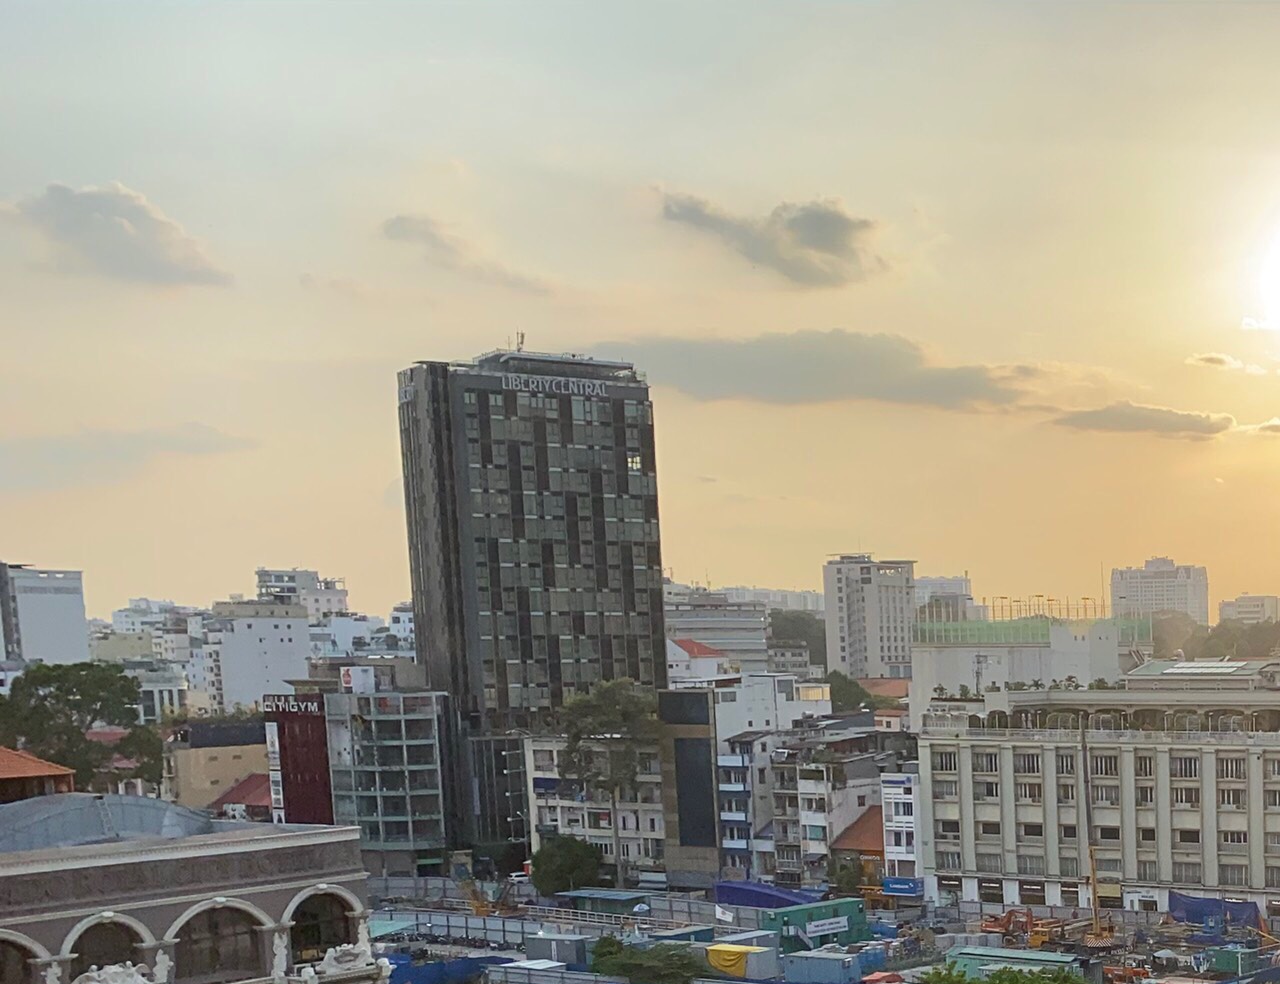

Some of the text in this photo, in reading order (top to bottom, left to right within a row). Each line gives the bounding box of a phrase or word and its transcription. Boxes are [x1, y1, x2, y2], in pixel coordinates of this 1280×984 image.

[502, 376, 609, 396] LIBERTY CENTRAL
[264, 701, 318, 712] CITIGYM
